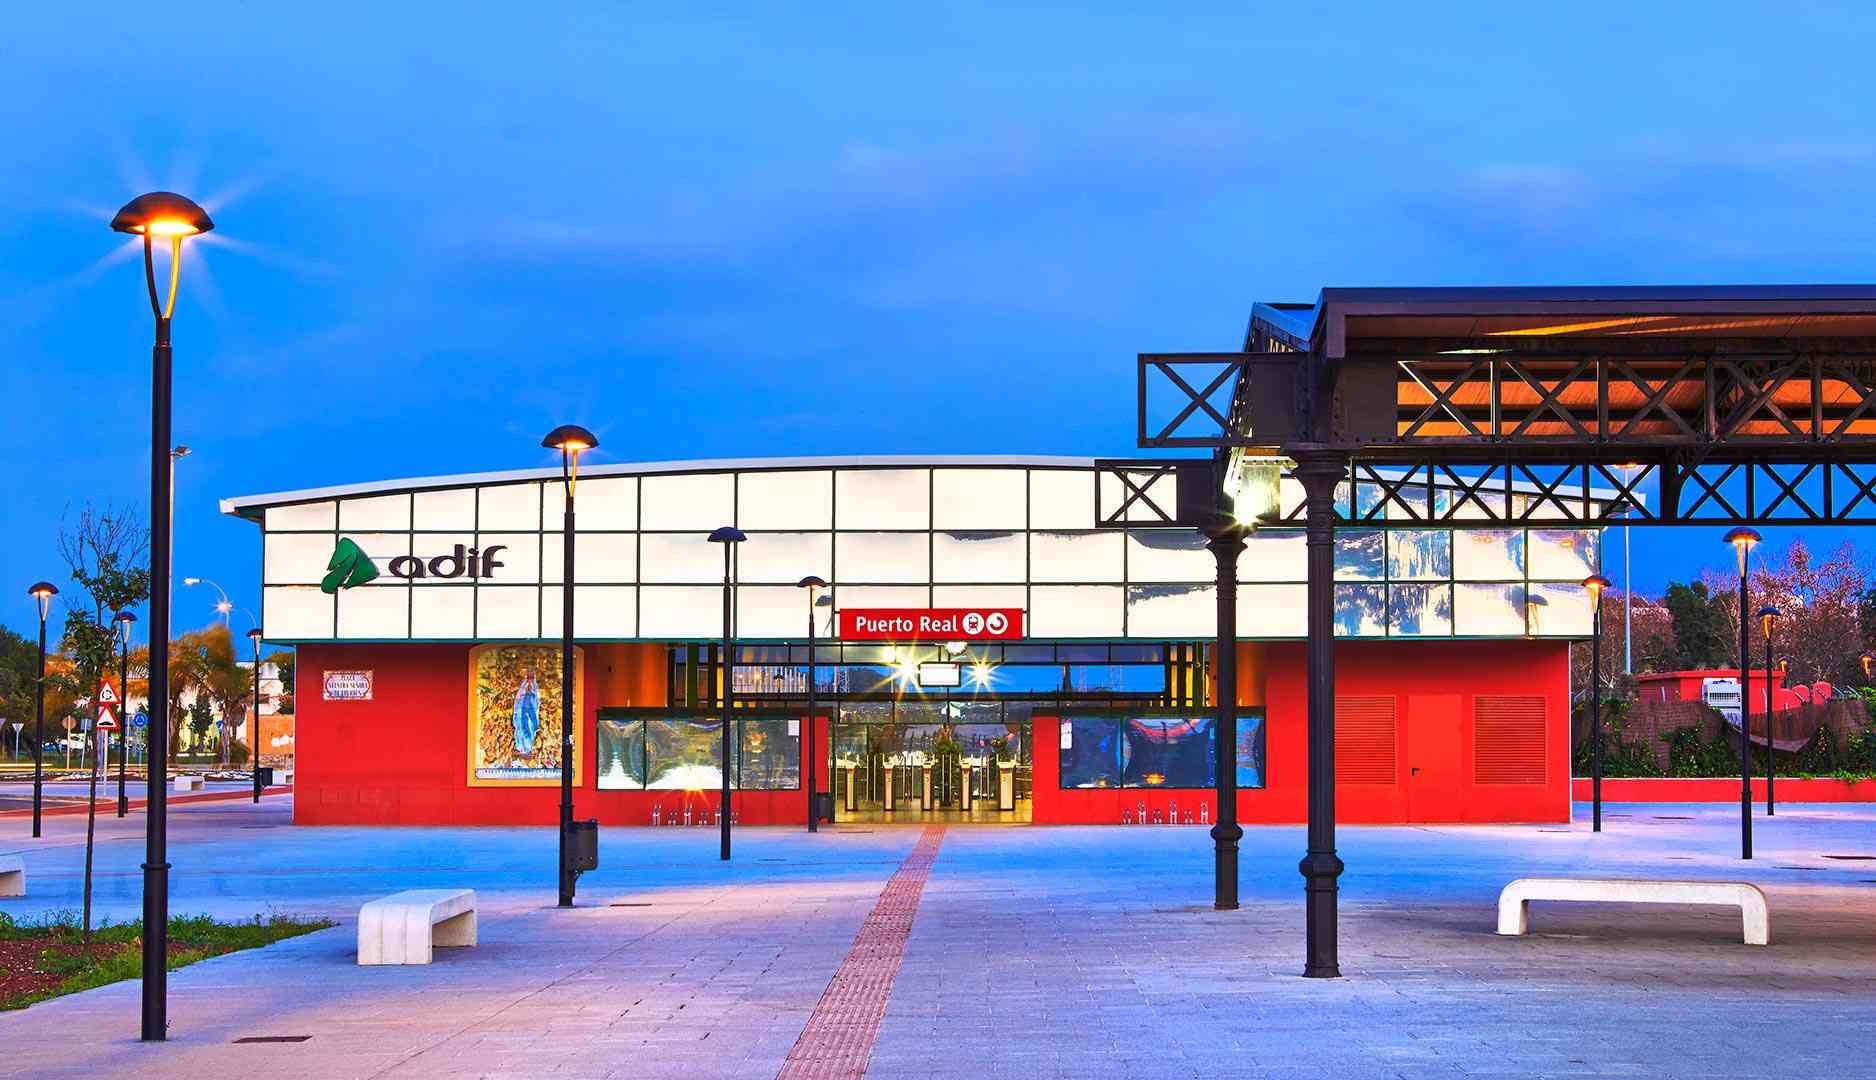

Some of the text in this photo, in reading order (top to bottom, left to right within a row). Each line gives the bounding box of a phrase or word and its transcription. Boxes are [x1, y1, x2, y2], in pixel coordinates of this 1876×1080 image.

[388, 544, 508, 578] adif
[856, 615, 958, 632] Puerto Real
